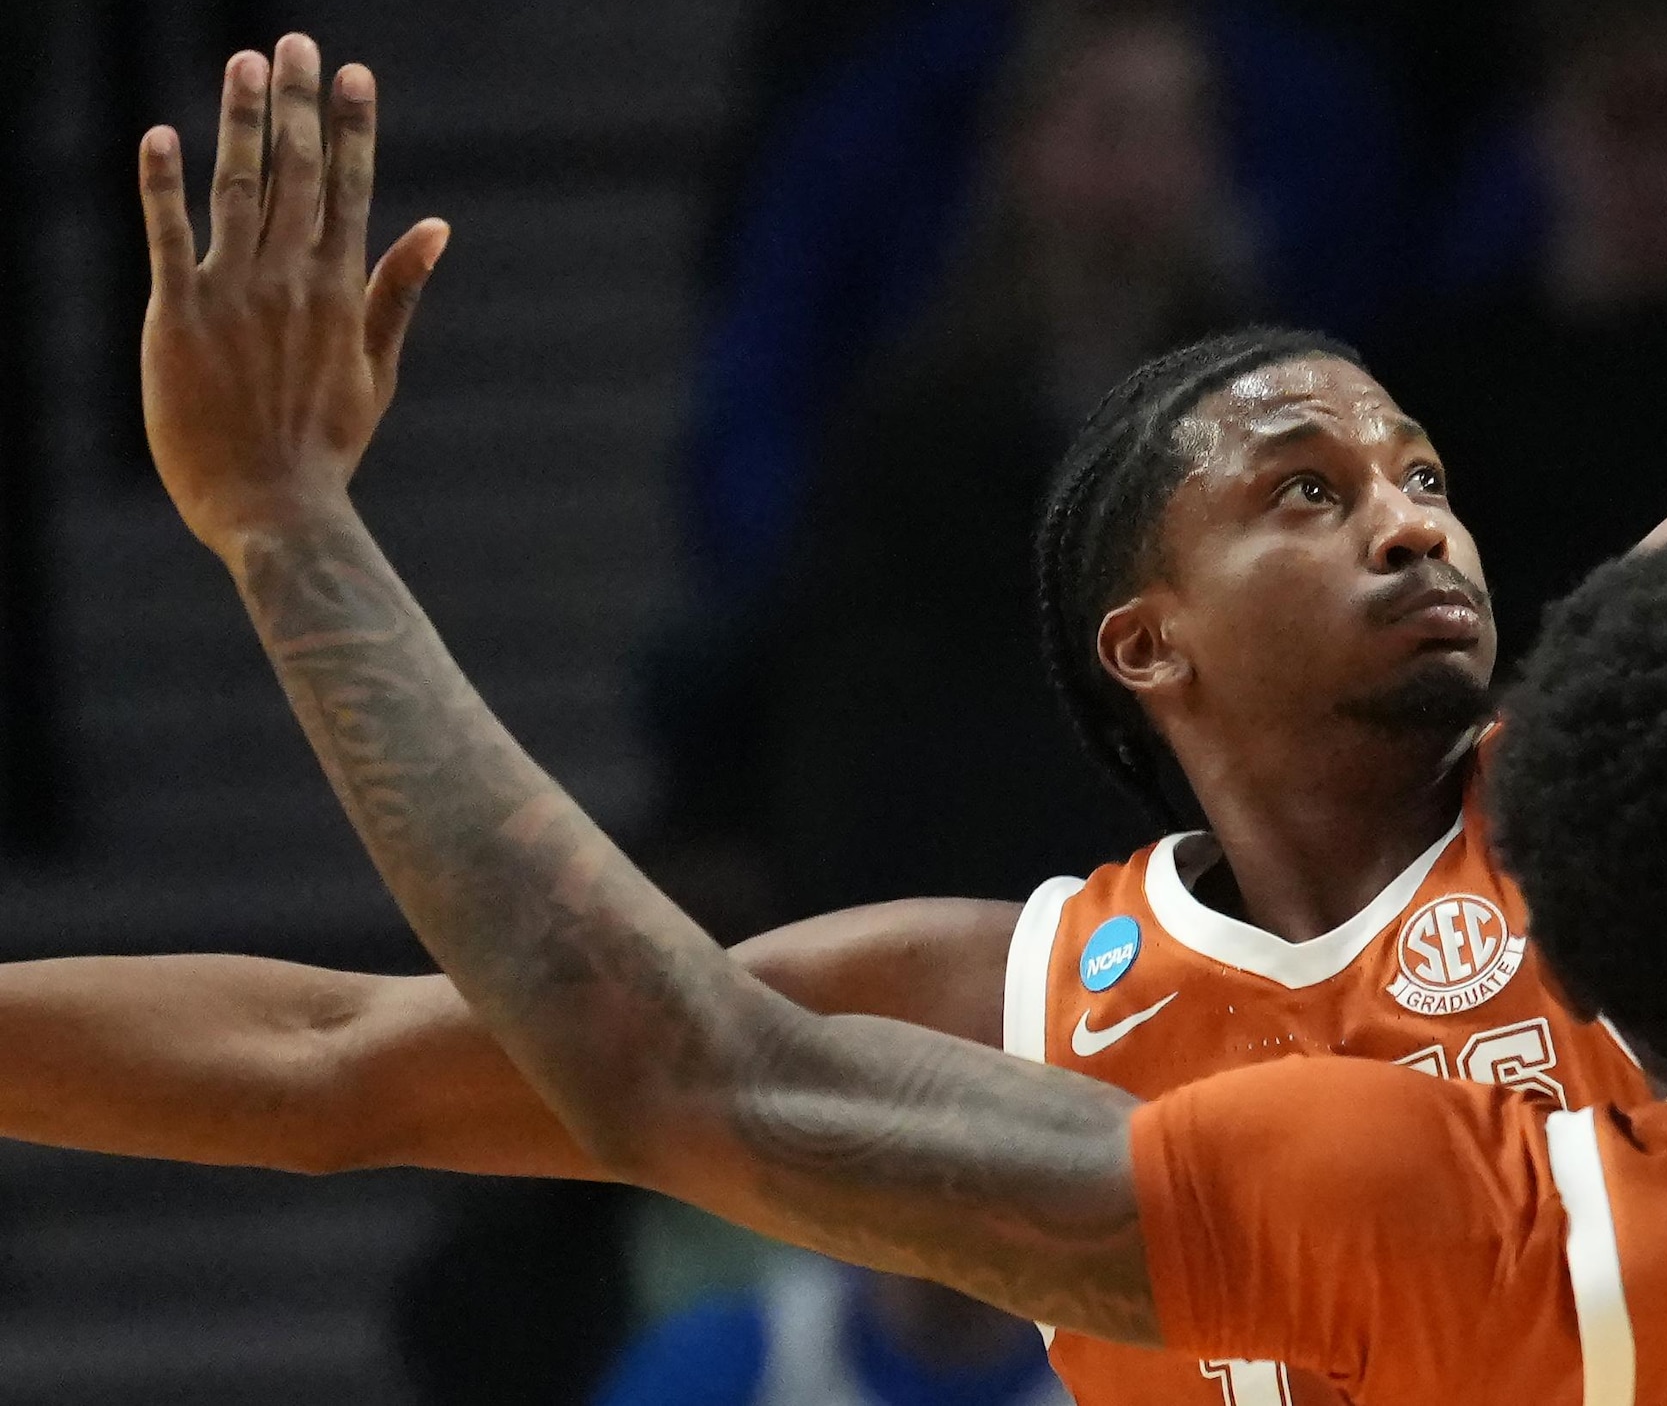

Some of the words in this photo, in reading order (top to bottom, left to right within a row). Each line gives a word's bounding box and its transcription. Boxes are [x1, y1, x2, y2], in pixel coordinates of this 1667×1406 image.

[1086, 942, 1135, 980] NCAA
[1407, 901, 1497, 984] SEC
[1406, 960, 1515, 1013] GRADUATE
